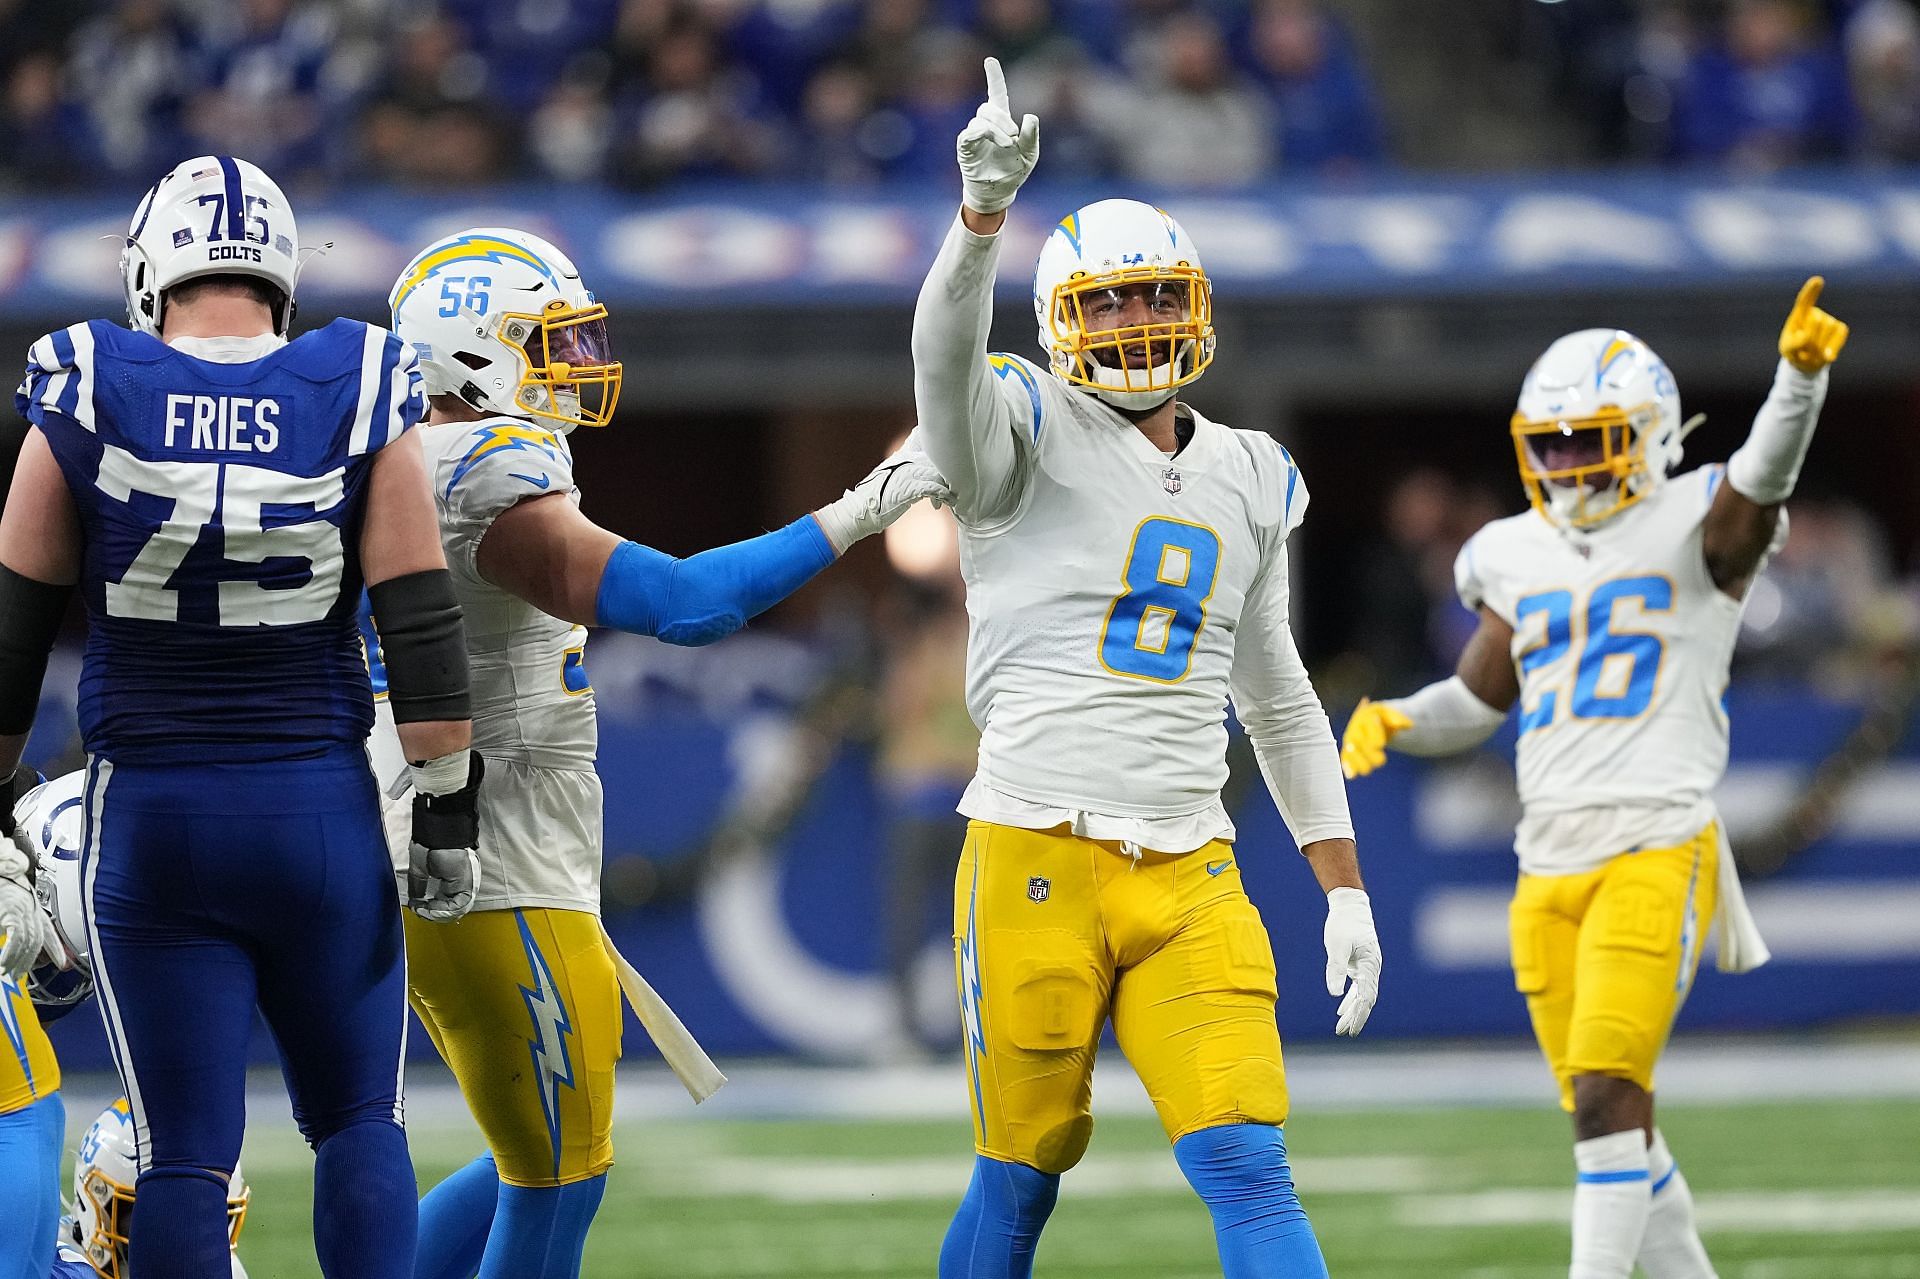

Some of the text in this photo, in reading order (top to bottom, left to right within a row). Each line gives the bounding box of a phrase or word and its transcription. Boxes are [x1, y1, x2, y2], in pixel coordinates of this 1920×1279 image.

[199, 193, 269, 245] 75
[209, 246, 261, 262] COLTS
[1122, 253, 1143, 267] LA
[438, 276, 492, 318] 56
[165, 394, 279, 452] FRIES
[94, 443, 347, 626] 75
[1097, 515, 1222, 685] 8
[1515, 572, 1675, 738] 26
